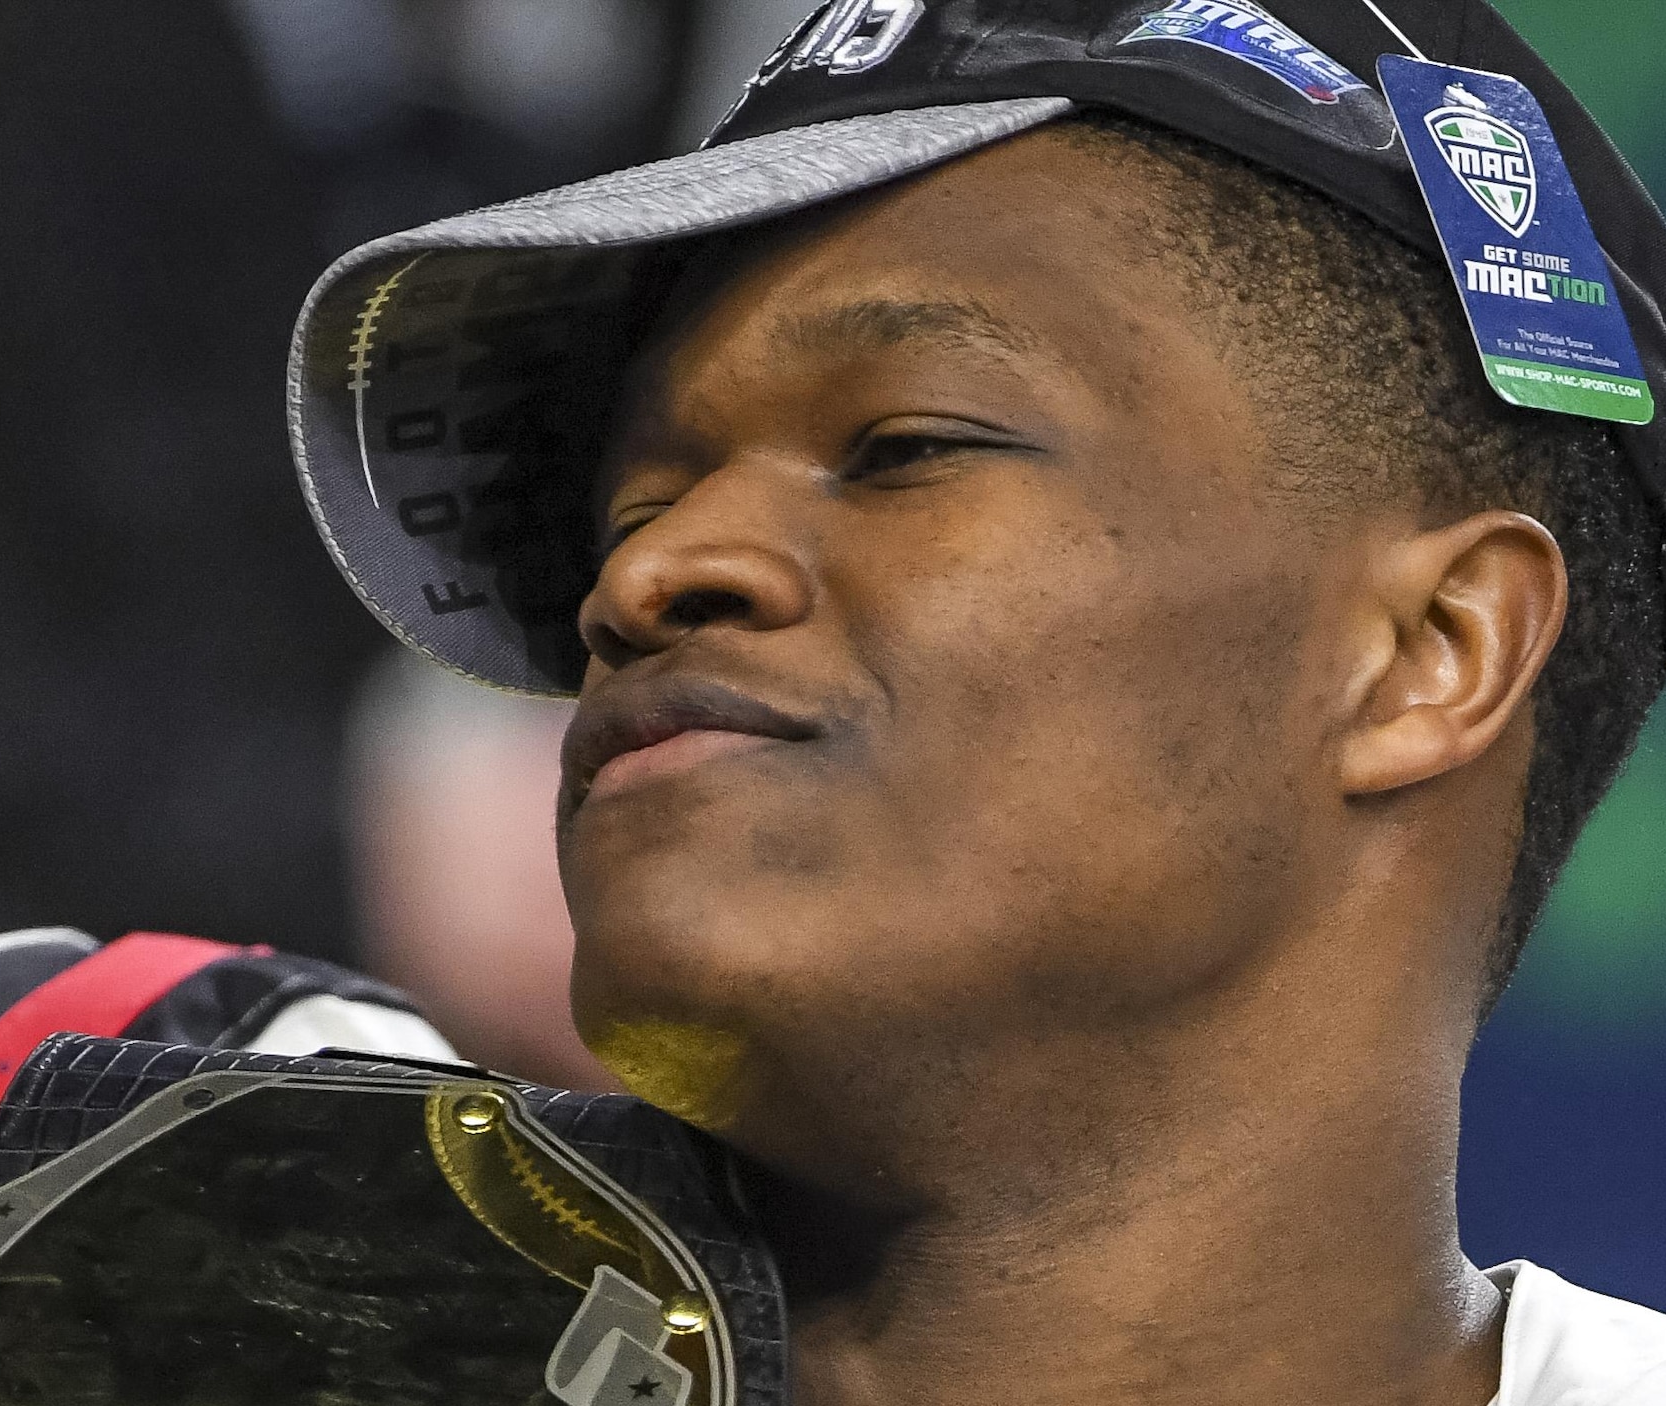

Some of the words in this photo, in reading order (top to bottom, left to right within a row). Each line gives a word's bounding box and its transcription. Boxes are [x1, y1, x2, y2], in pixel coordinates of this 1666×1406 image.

[1447, 144, 1531, 185] MAC
[1483, 244, 1518, 264] GET
[1521, 251, 1572, 273] SOME
[1463, 259, 1606, 306] MACTION
